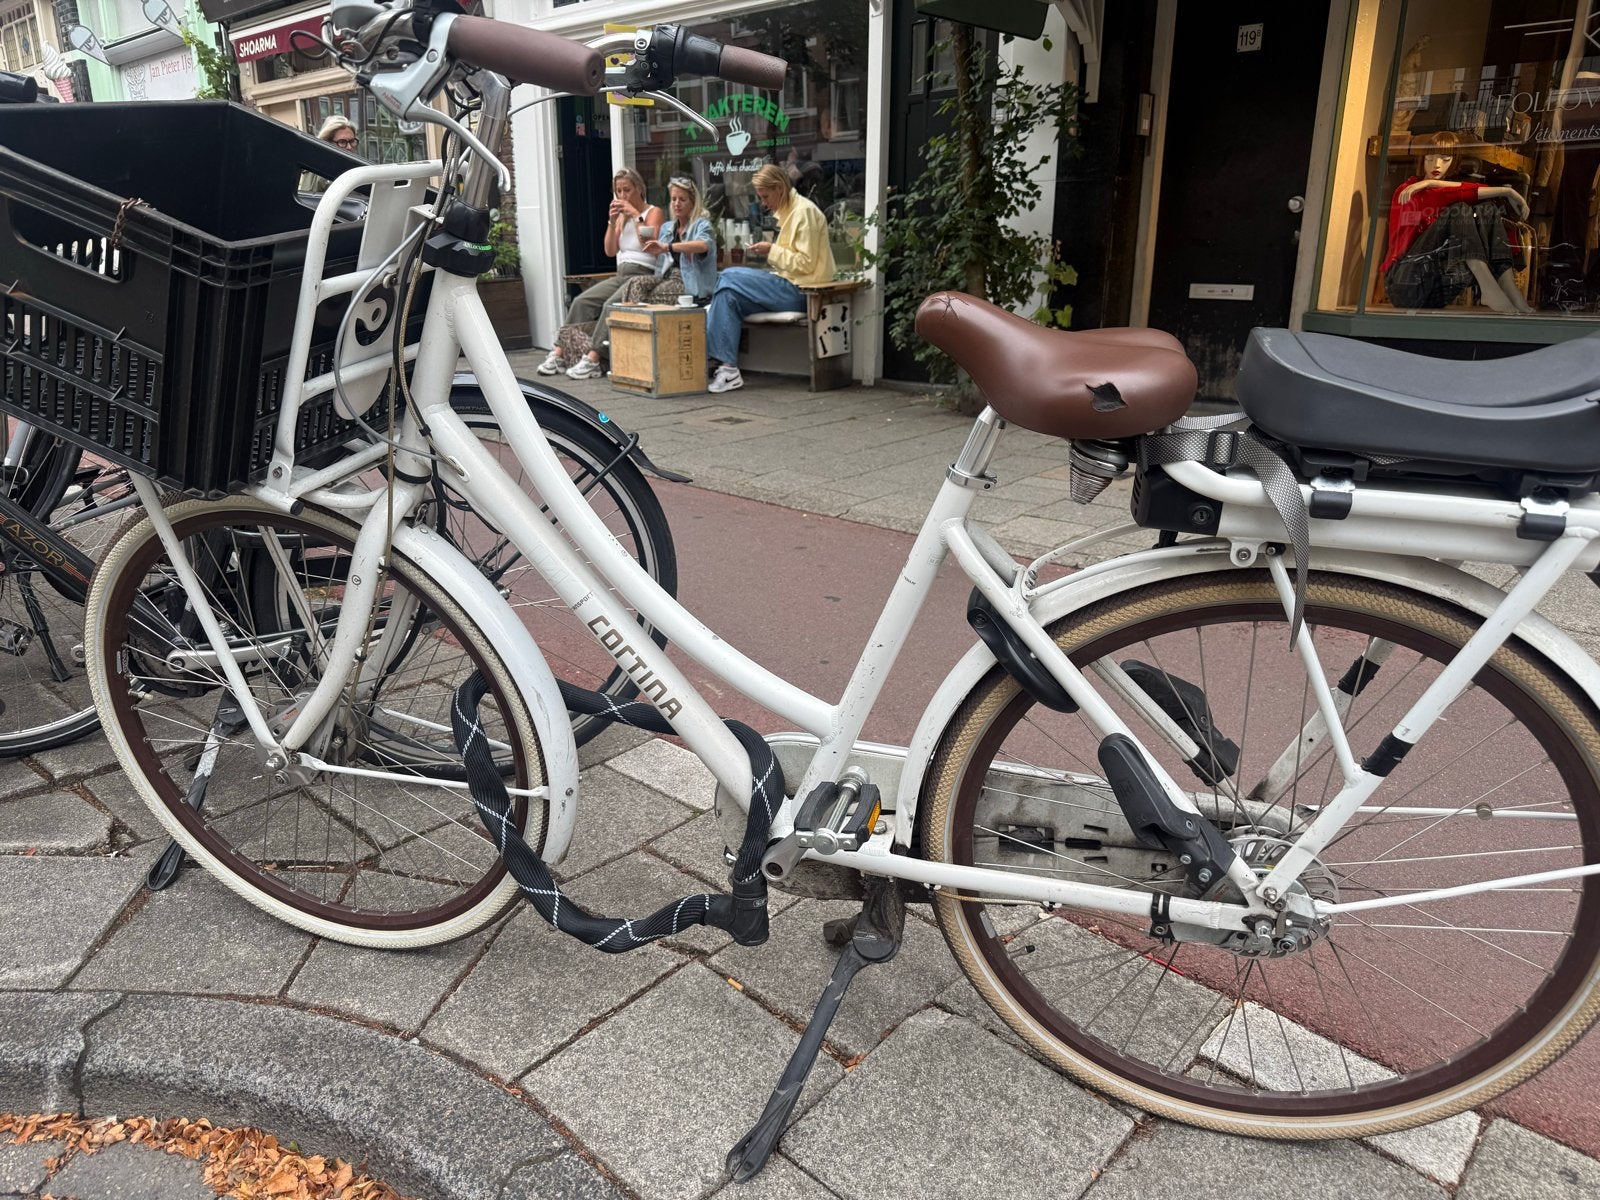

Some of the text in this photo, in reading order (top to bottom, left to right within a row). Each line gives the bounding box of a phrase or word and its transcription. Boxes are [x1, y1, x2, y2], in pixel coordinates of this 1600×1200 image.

[238, 33, 278, 58] SHOARMA
[149, 62, 161, 82] Jan
[160, 57, 180, 76] Pieter
[7, 524, 66, 566] AZOR
[587, 614, 684, 721] CORTINA
